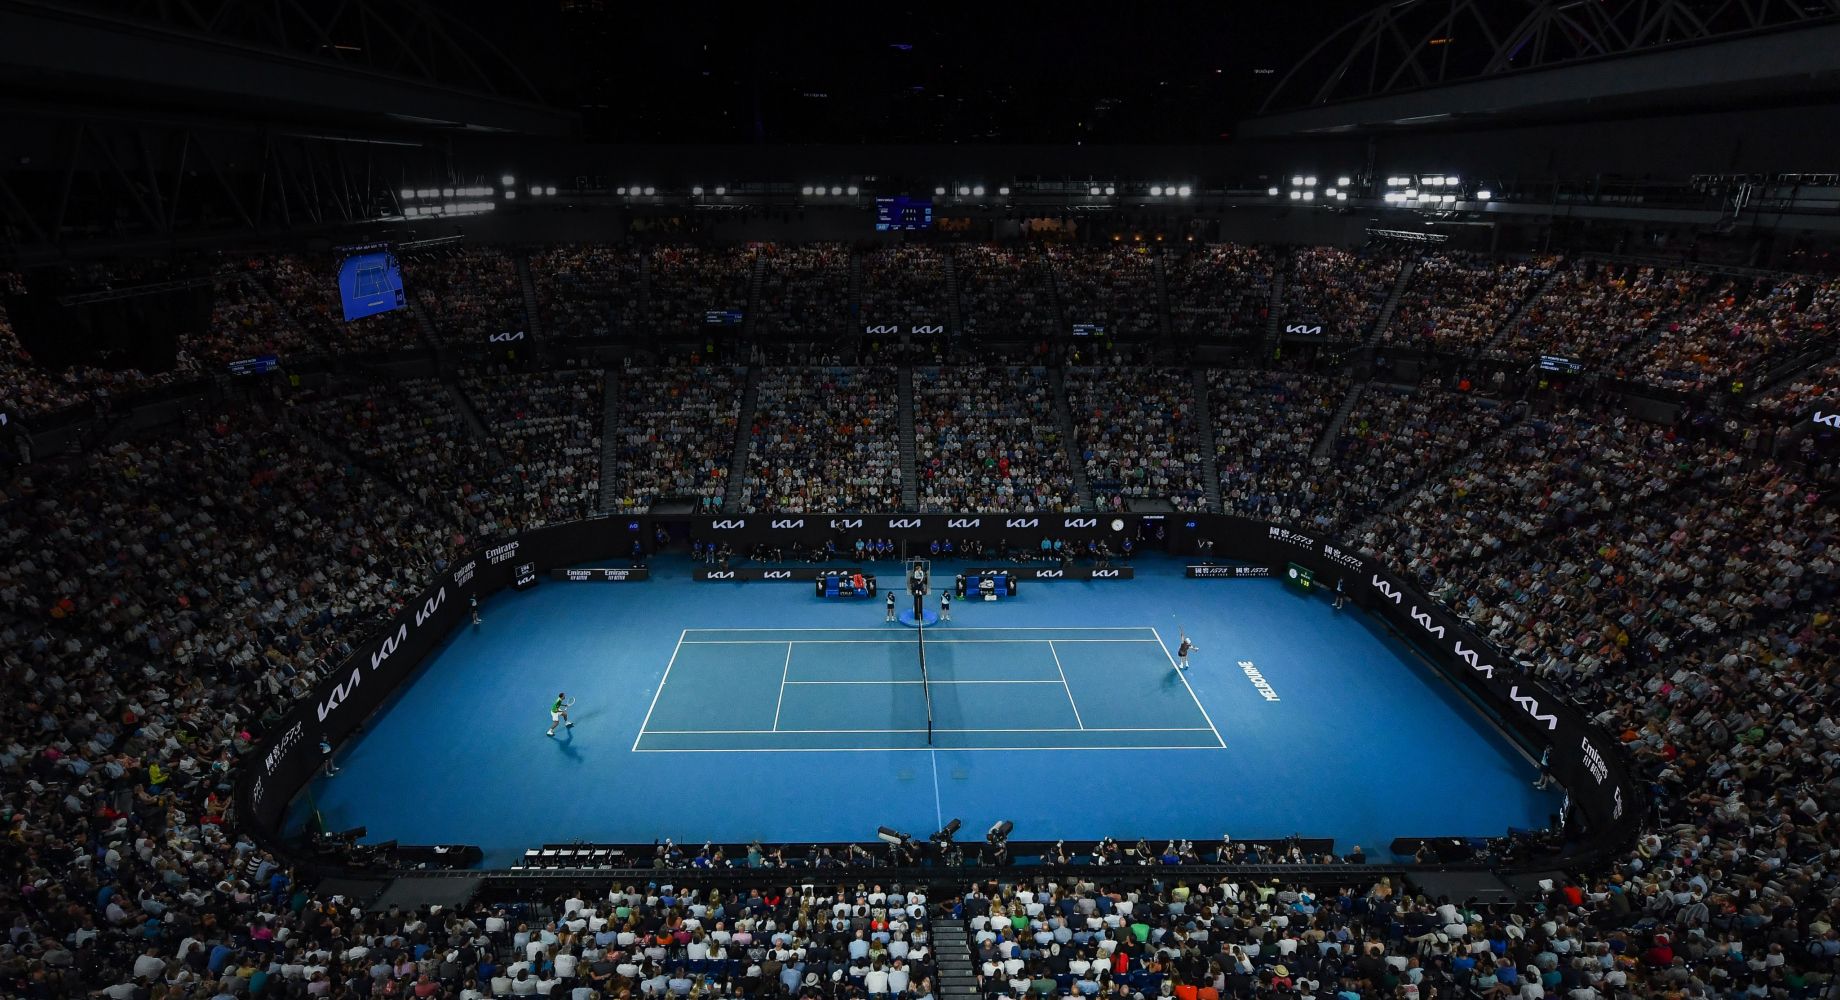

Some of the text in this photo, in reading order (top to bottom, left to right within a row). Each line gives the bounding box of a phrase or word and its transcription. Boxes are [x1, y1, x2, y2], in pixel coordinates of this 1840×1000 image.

[867, 325, 898, 334] KIA
[912, 325, 943, 334] KIA
[1286, 324, 1321, 335] KIA
[490, 331, 524, 342] KIA
[1813, 411, 1840, 428] KI
[712, 519, 744, 529] KIA
[771, 519, 804, 529] KIA
[889, 518, 921, 528] KIA
[948, 518, 980, 528] KIA
[1006, 518, 1038, 528] KIA
[1065, 518, 1097, 528] KIA
[485, 541, 519, 560] Emirates
[453, 560, 476, 583] Emirates
[707, 571, 734, 579] KIA
[763, 570, 791, 579] KIA
[1036, 569, 1063, 578] KIA
[1092, 569, 1119, 577] KIA
[1372, 574, 1402, 604] KIA
[415, 586, 446, 627] KIA
[1410, 606, 1445, 639] KIA
[371, 623, 408, 670] KIA
[1454, 641, 1495, 679] KIA
[1237, 661, 1281, 701] MELBOURNE
[317, 667, 361, 722] KIA
[1510, 686, 1558, 730] KIA
[1581, 736, 1608, 779] Emirates
